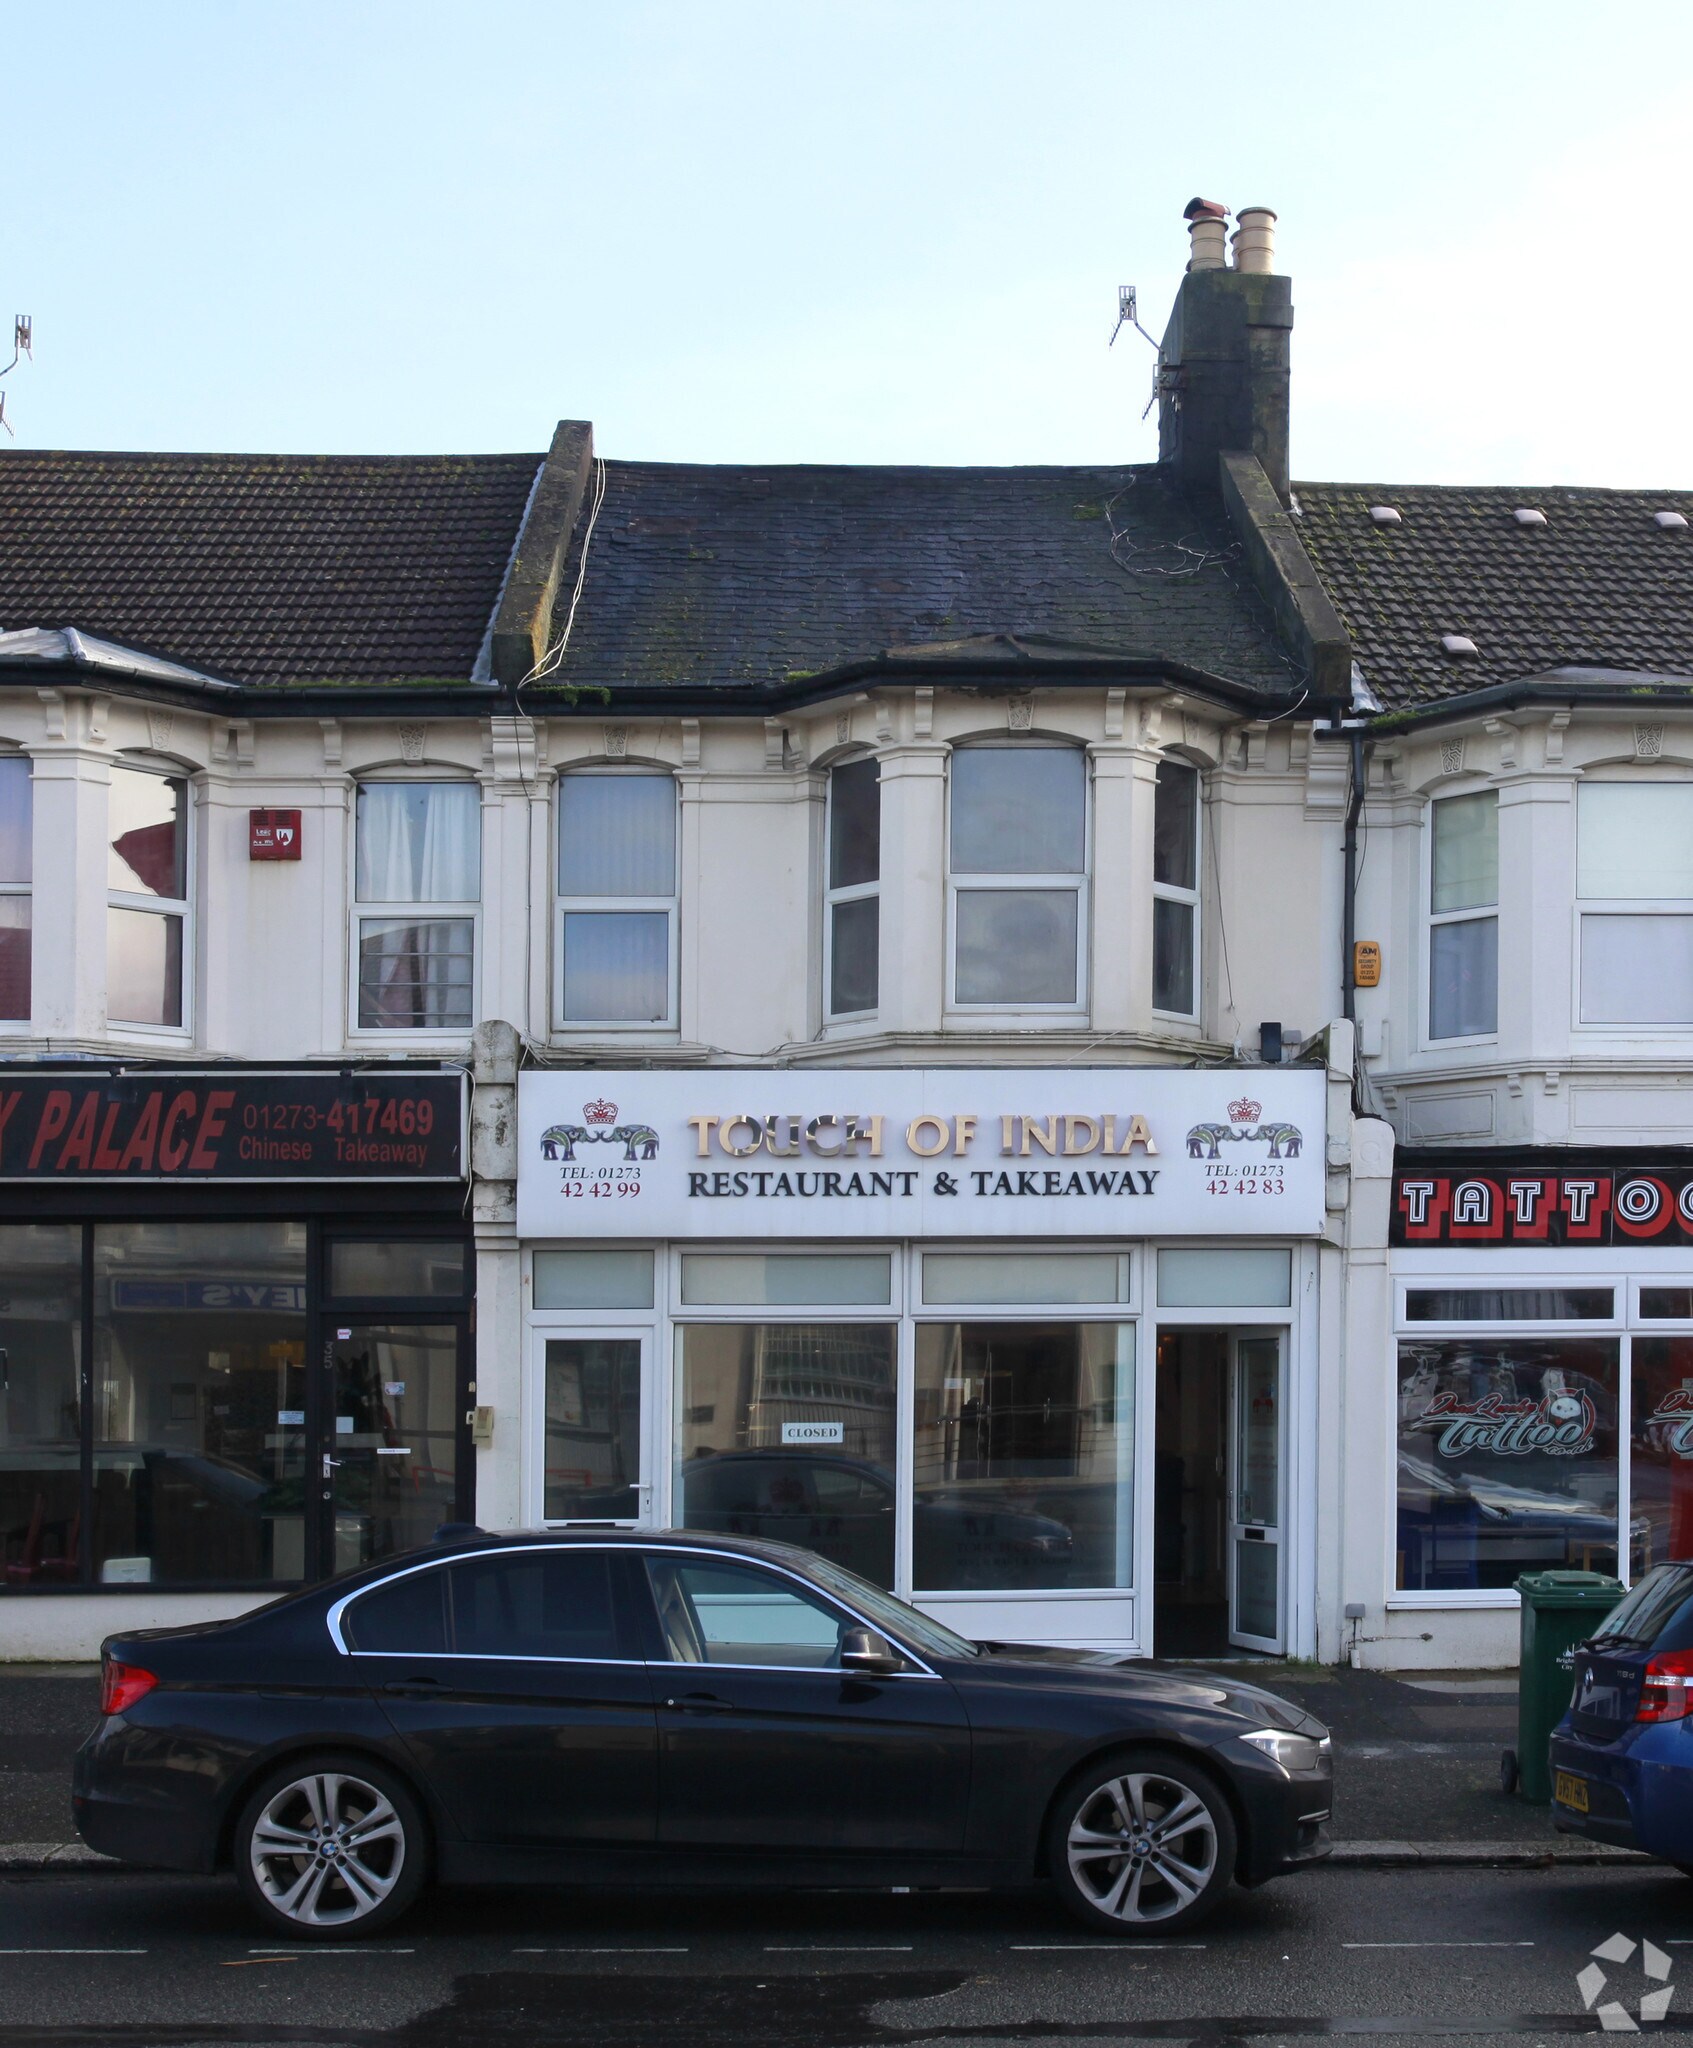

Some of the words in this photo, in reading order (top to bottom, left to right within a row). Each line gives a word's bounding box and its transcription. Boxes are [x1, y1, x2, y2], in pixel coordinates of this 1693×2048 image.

[27, 1090, 236, 1171] PALACE
[243, 1099, 434, 1135] 01273-417469
[688, 1114, 885, 1158] TOUCH
[906, 1115, 978, 1157] OF
[1000, 1114, 1160, 1156] INDIA
[239, 1137, 312, 1160] Chinese
[335, 1137, 427, 1168] Takeaway
[559, 1167, 594, 1179] TEL:
[598, 1167, 641, 1179] 01273
[688, 1171, 919, 1197] RESTAURANT
[933, 1171, 958, 1196] &
[971, 1170, 1160, 1196] TAKEAWAY
[1204, 1165, 1239, 1177] TEL:
[1242, 1164, 1284, 1177] 01273
[560, 1182, 584, 1198] 42
[589, 1182, 612, 1198] 42
[617, 1182, 641, 1198] 99
[1206, 1180, 1228, 1195] 42
[1234, 1180, 1257, 1195] 42
[1262, 1180, 1284, 1195] 83
[788, 1428, 837, 1437] CLOSED
[1410, 1413, 1584, 1458] Tattoo
